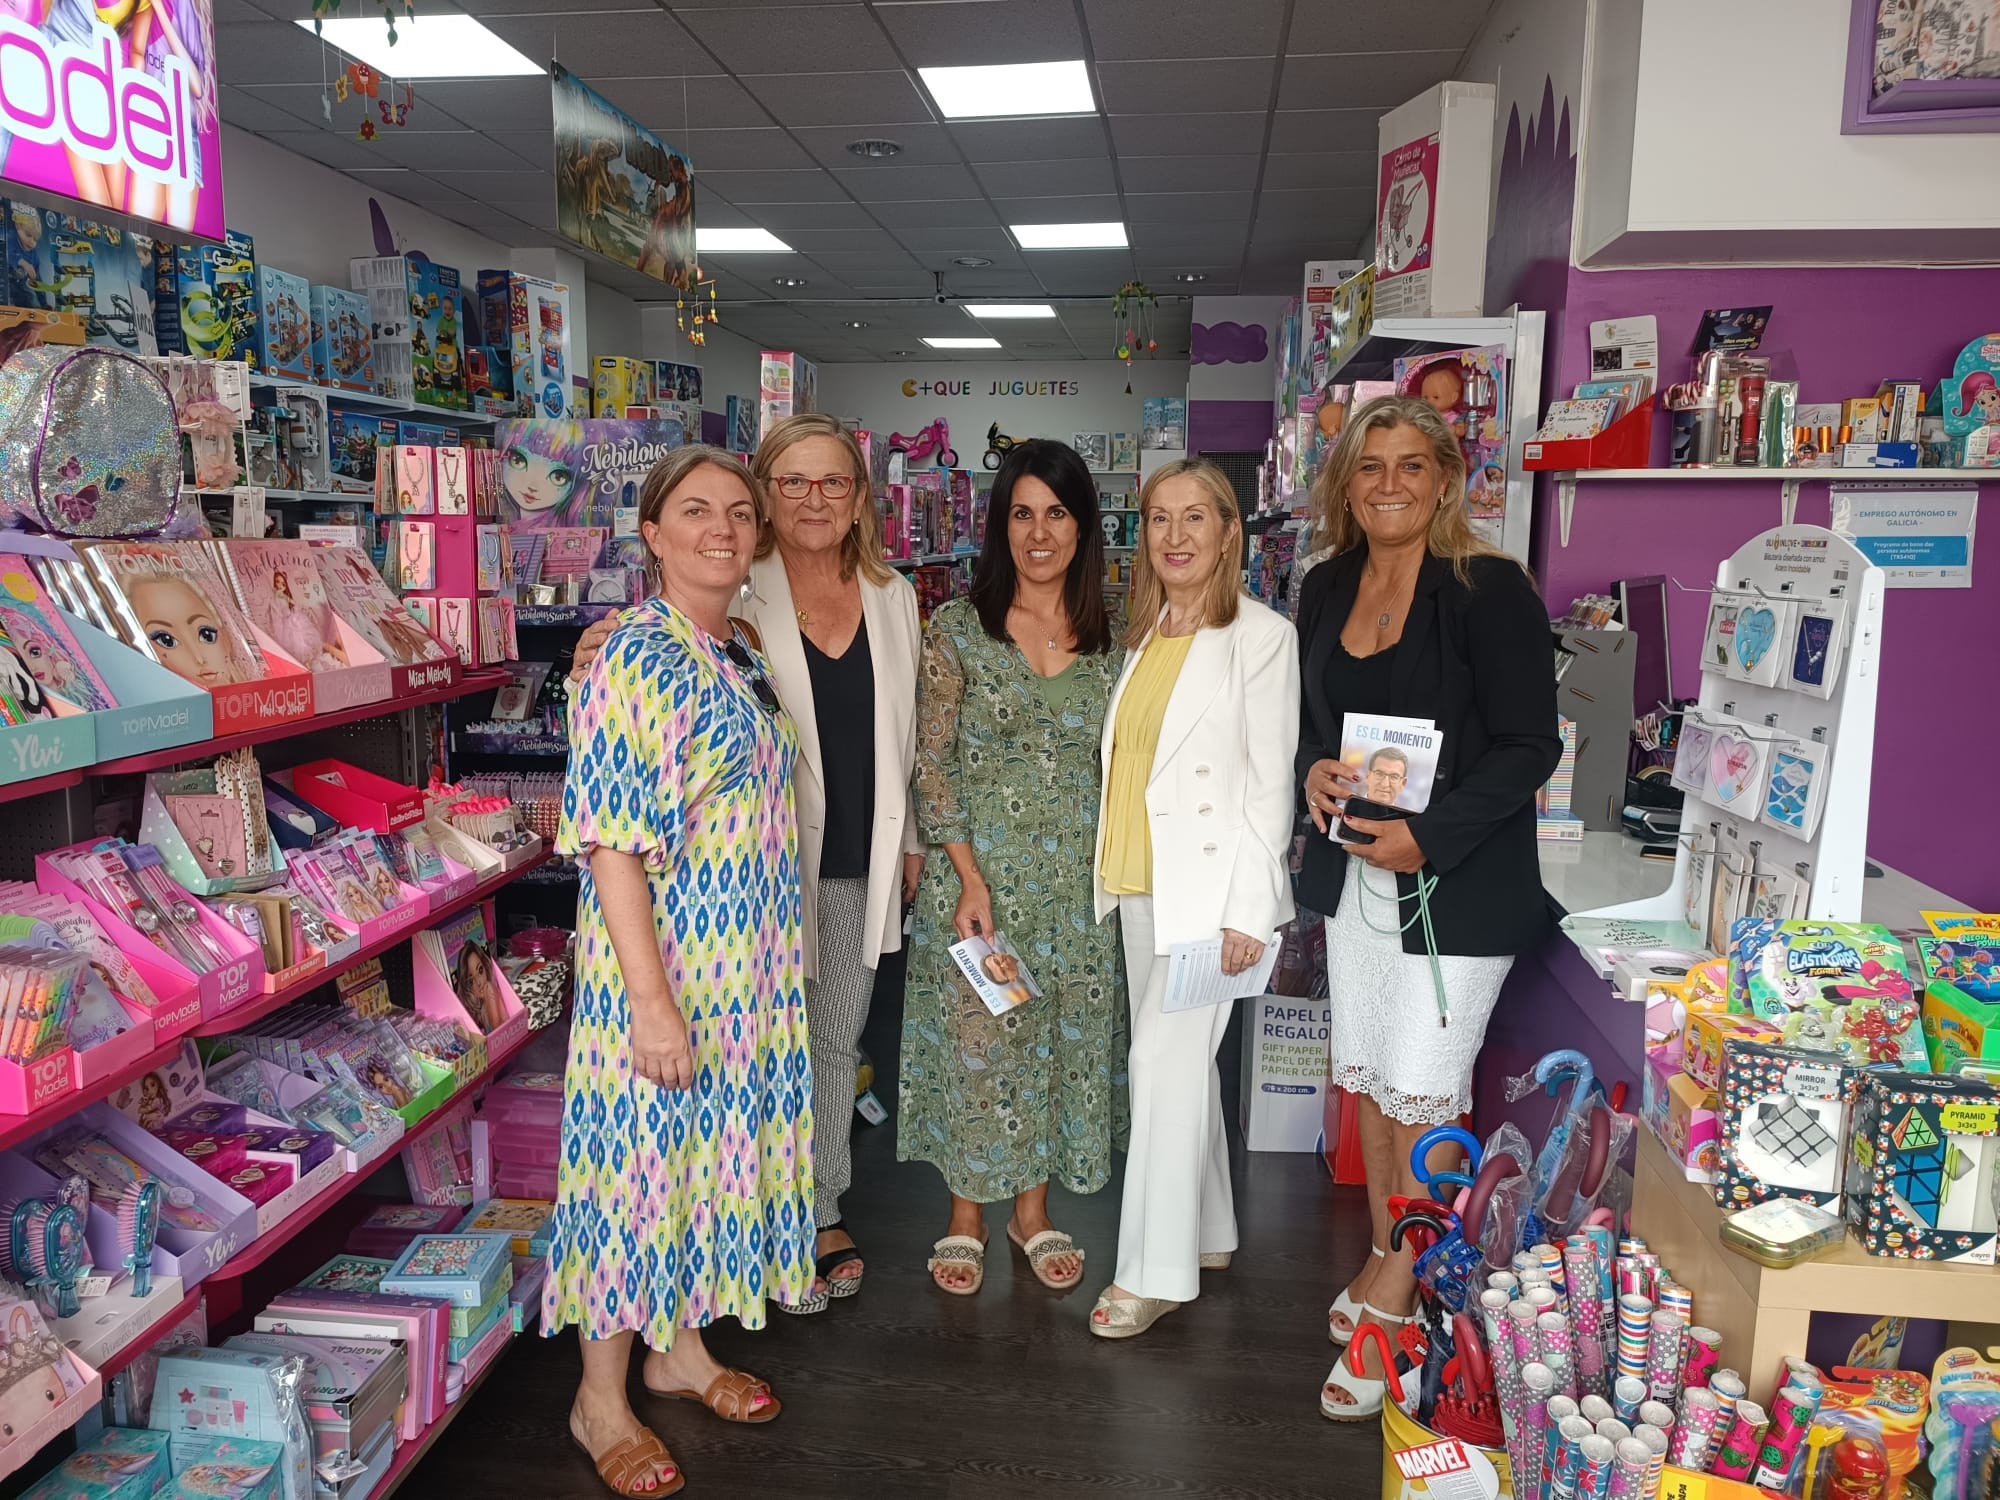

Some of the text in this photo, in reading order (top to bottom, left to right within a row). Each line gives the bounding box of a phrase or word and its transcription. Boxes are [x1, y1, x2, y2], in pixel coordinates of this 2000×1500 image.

[989, 380, 1079, 396] JUGUETES
[581, 437, 668, 473] Nebulous
[586, 502, 614, 513] nebul
[1859, 510, 1897, 518] EMPREGO
[1898, 508, 1946, 518] AUTÓNOMO
[1886, 519, 1918, 527] GALICIA
[333, 568, 359, 585] DIY
[408, 661, 452, 689] Miss Melody
[215, 679, 311, 720] TOPModel
[121, 708, 190, 737] TOPModel
[1355, 724, 1433, 750] ES EL MOMENTO
[11, 734, 65, 773] Ylvi
[551, 742, 573, 753] Star
[1975, 939, 2000, 947] POWE
[1788, 941, 1863, 973] ELASTIKORPS
[217, 960, 249, 991] TOP
[955, 948, 988, 989] MOMENTO
[218, 979, 249, 1006] Model
[1704, 993, 1726, 1003] CREAM
[154, 997, 201, 1031] TOPModel
[1264, 1005, 1332, 1023] PAPEL D
[1263, 1023, 1329, 1041] REGALO
[1262, 1043, 1323, 1056] GIFT PAPER
[1261, 1054, 1329, 1067] PAPEL DE PR
[32, 1054, 68, 1085] TOP
[1261, 1065, 1331, 1077] PAPIER CADE
[34, 1072, 69, 1099] Model
[1795, 1073, 1827, 1085] MIRROR
[1283, 1086, 1297, 1094] 200
[1799, 1085, 1820, 1093] 3x3x3
[1950, 1111, 1986, 1121] PYRAMID
[1957, 1121, 1977, 1129] 3x3x3
[205, 1232, 238, 1268] Ylvi
[1970, 1251, 1991, 1263] cayro
[330, 1345, 386, 1355] MAGICAL
[1393, 1440, 1467, 1479] MARVEL
